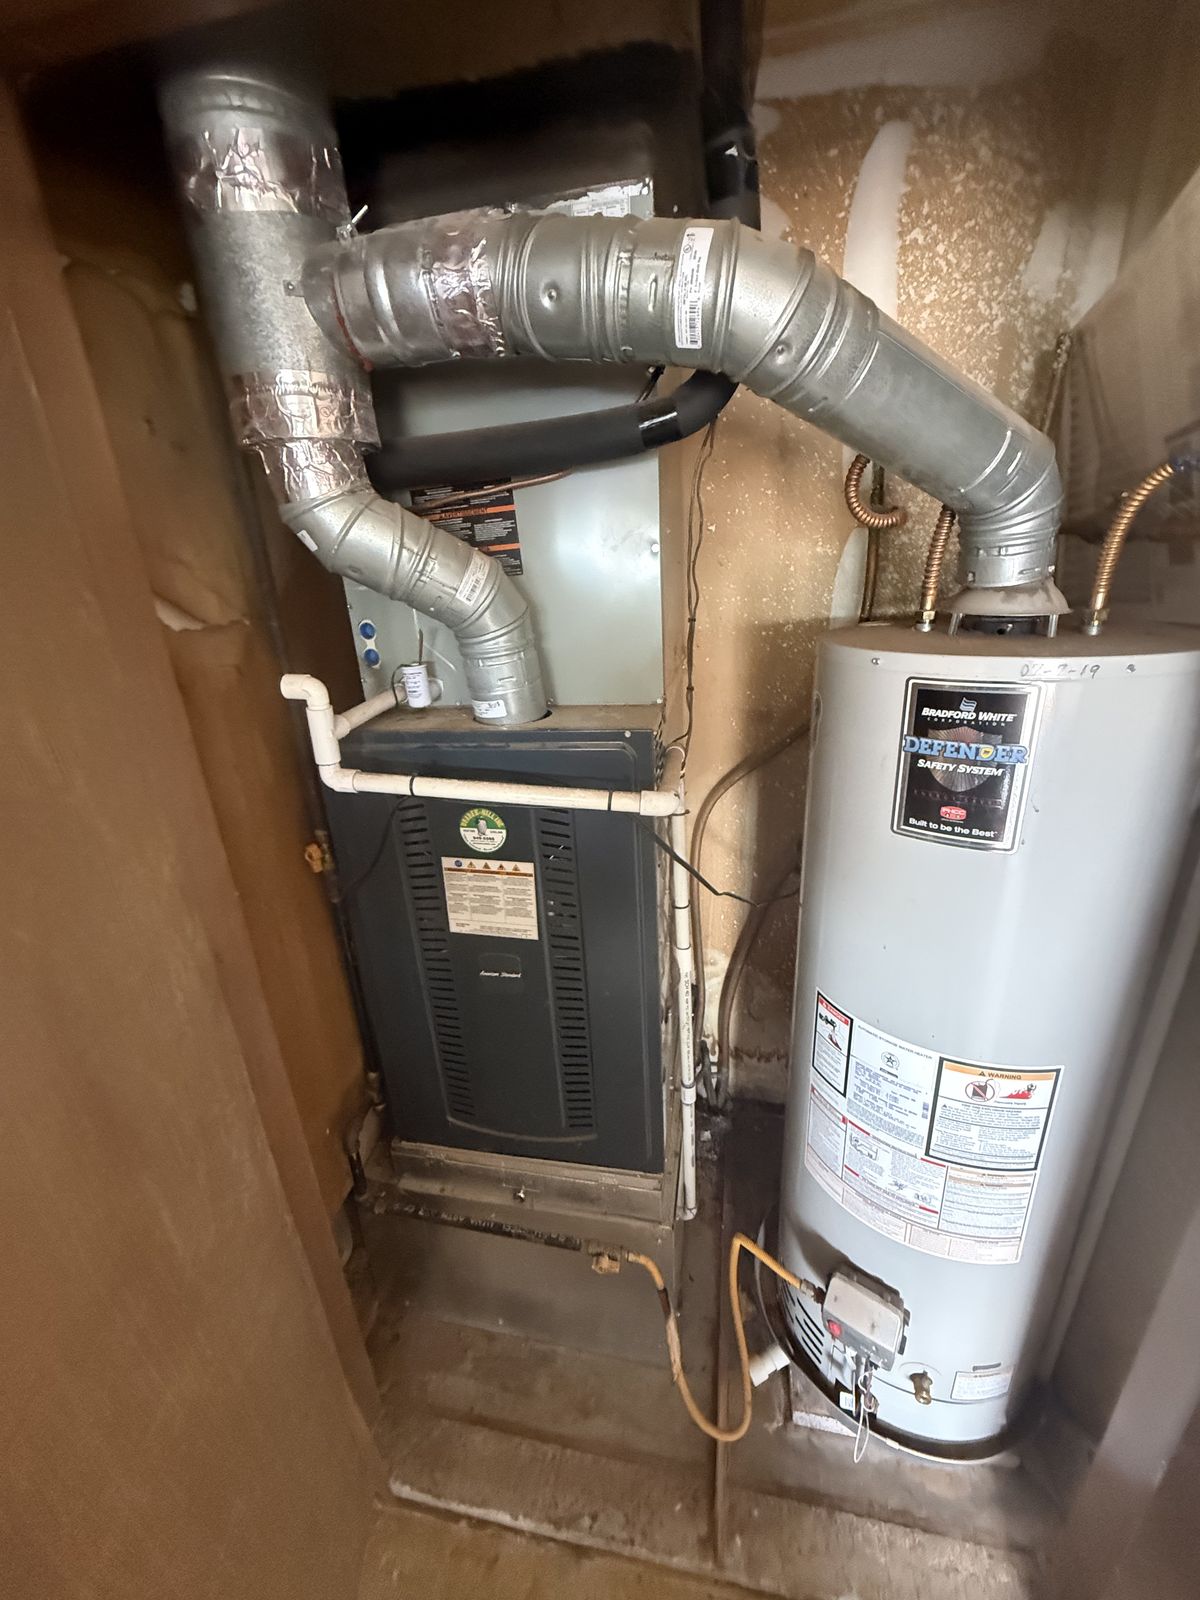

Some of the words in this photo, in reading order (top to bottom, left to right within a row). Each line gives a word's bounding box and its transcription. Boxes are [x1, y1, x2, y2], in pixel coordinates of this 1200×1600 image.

[921, 707, 977, 721] BRADFORD
[978, 711, 1016, 722] WHITE
[927, 717, 1006, 727] CORPORATION
[903, 735, 1027, 764] DEFENDER
[917, 758, 957, 772] SAFETY
[957, 764, 1004, 777] SYSTEM
[909, 817, 928, 829] Built
[929, 821, 939, 830] to
[940, 824, 952, 832] be
[954, 826, 970, 835] the
[972, 828, 995, 838] Best
[988, 1072, 1022, 1080] WARNING
